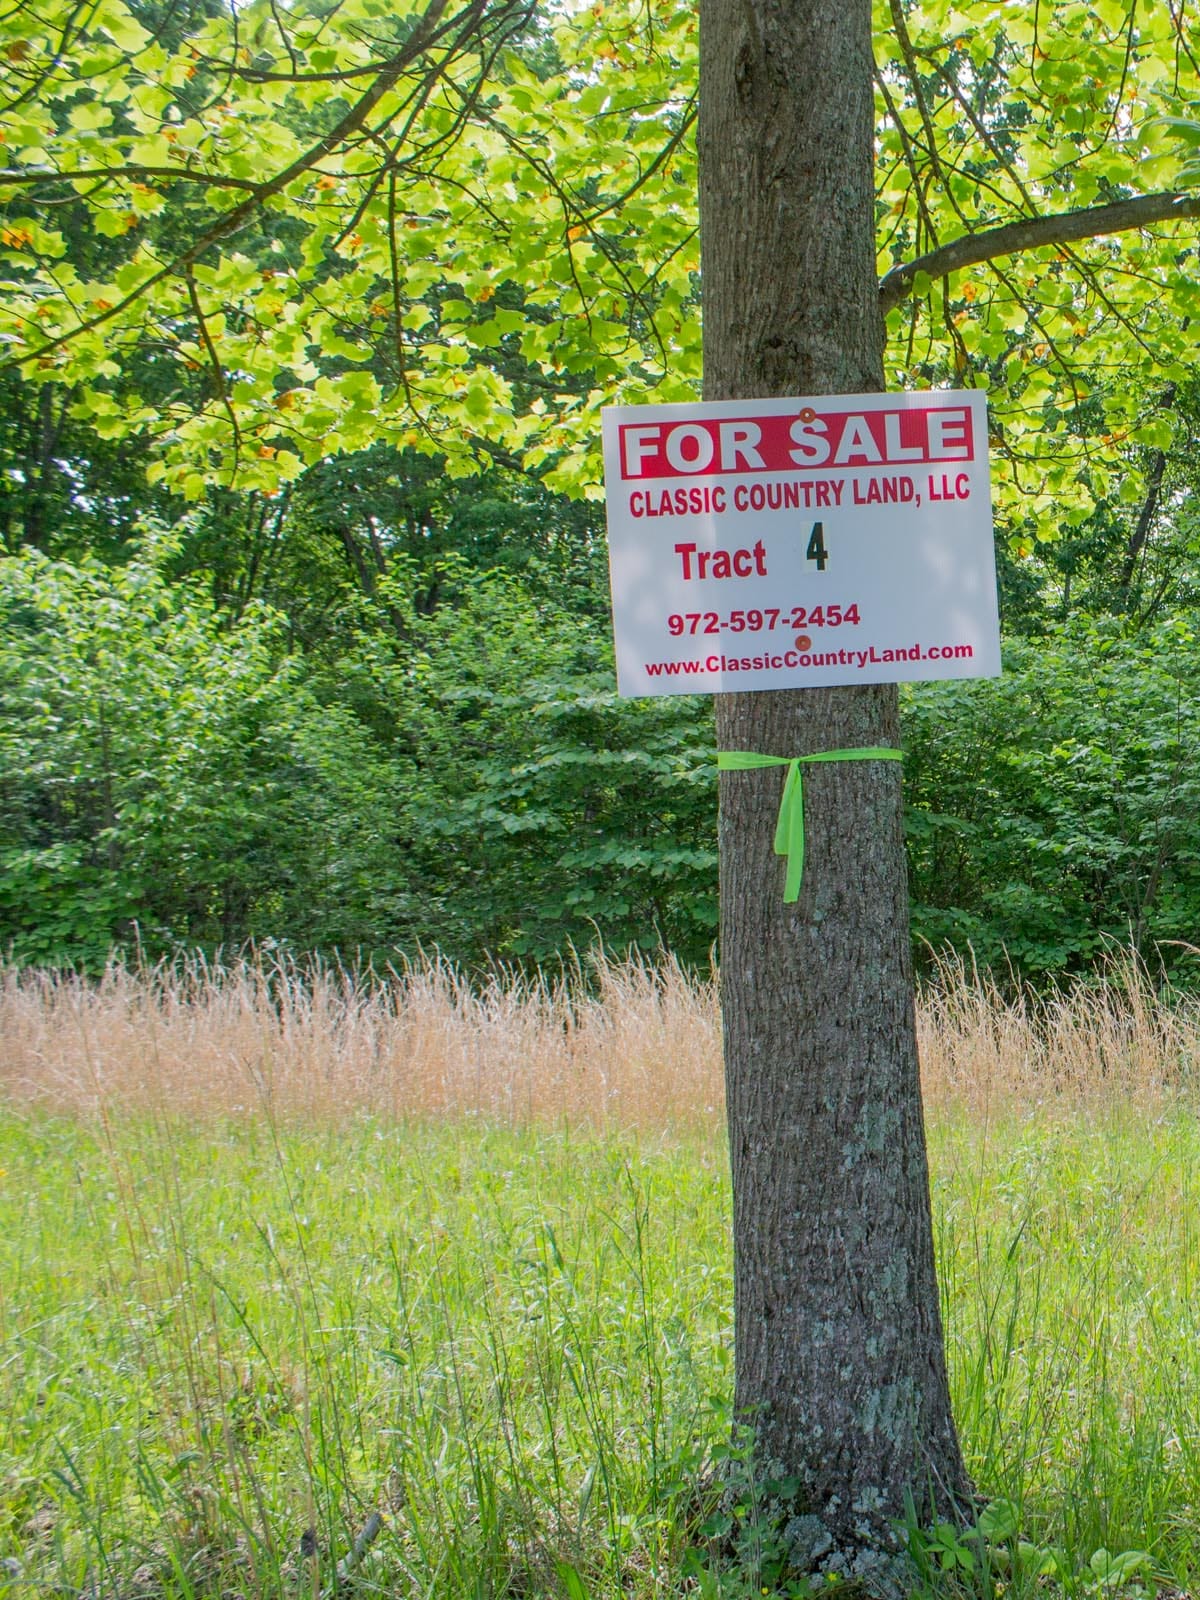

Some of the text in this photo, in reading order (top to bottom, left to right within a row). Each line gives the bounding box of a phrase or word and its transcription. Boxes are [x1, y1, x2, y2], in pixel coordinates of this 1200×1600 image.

[624, 411, 969, 476] FOR SALE
[630, 473, 971, 518] CLASSIC COUNTRY LAND, LLC
[675, 522, 828, 580] Tract 4
[667, 604, 861, 636] 972-597-2454
[645, 643, 973, 676] www.ClassicCountryLand.com
